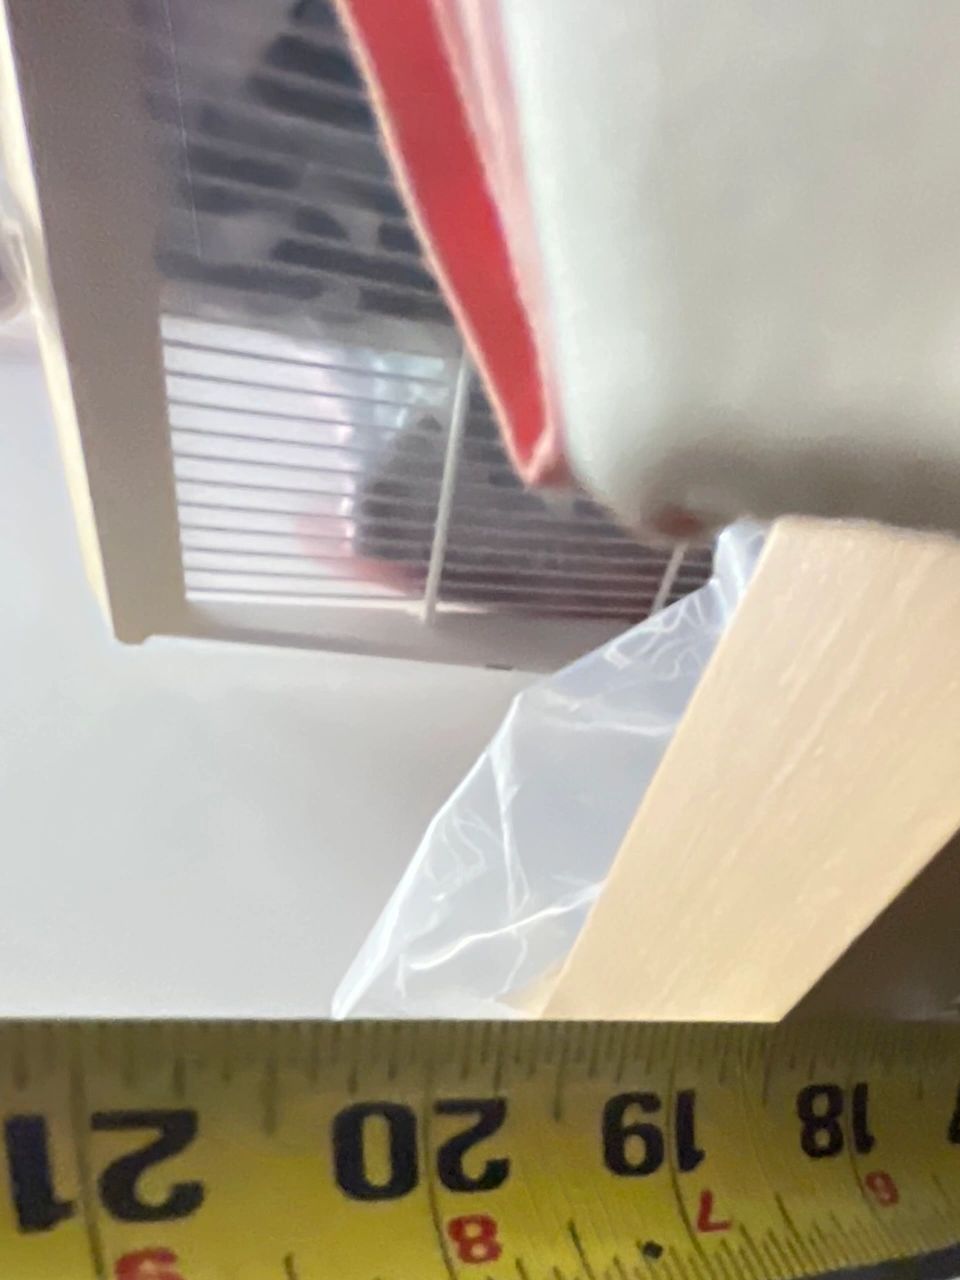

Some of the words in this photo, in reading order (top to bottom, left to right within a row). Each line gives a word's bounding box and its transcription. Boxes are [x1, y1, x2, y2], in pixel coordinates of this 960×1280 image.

[332, 1097, 510, 1202] 20
[601, 1089, 706, 1177] 19
[797, 1083, 876, 1159] 18
[4, 1108, 206, 1234] 21
[696, 1190, 732, 1233] 7
[447, 1214, 502, 1265] 8
